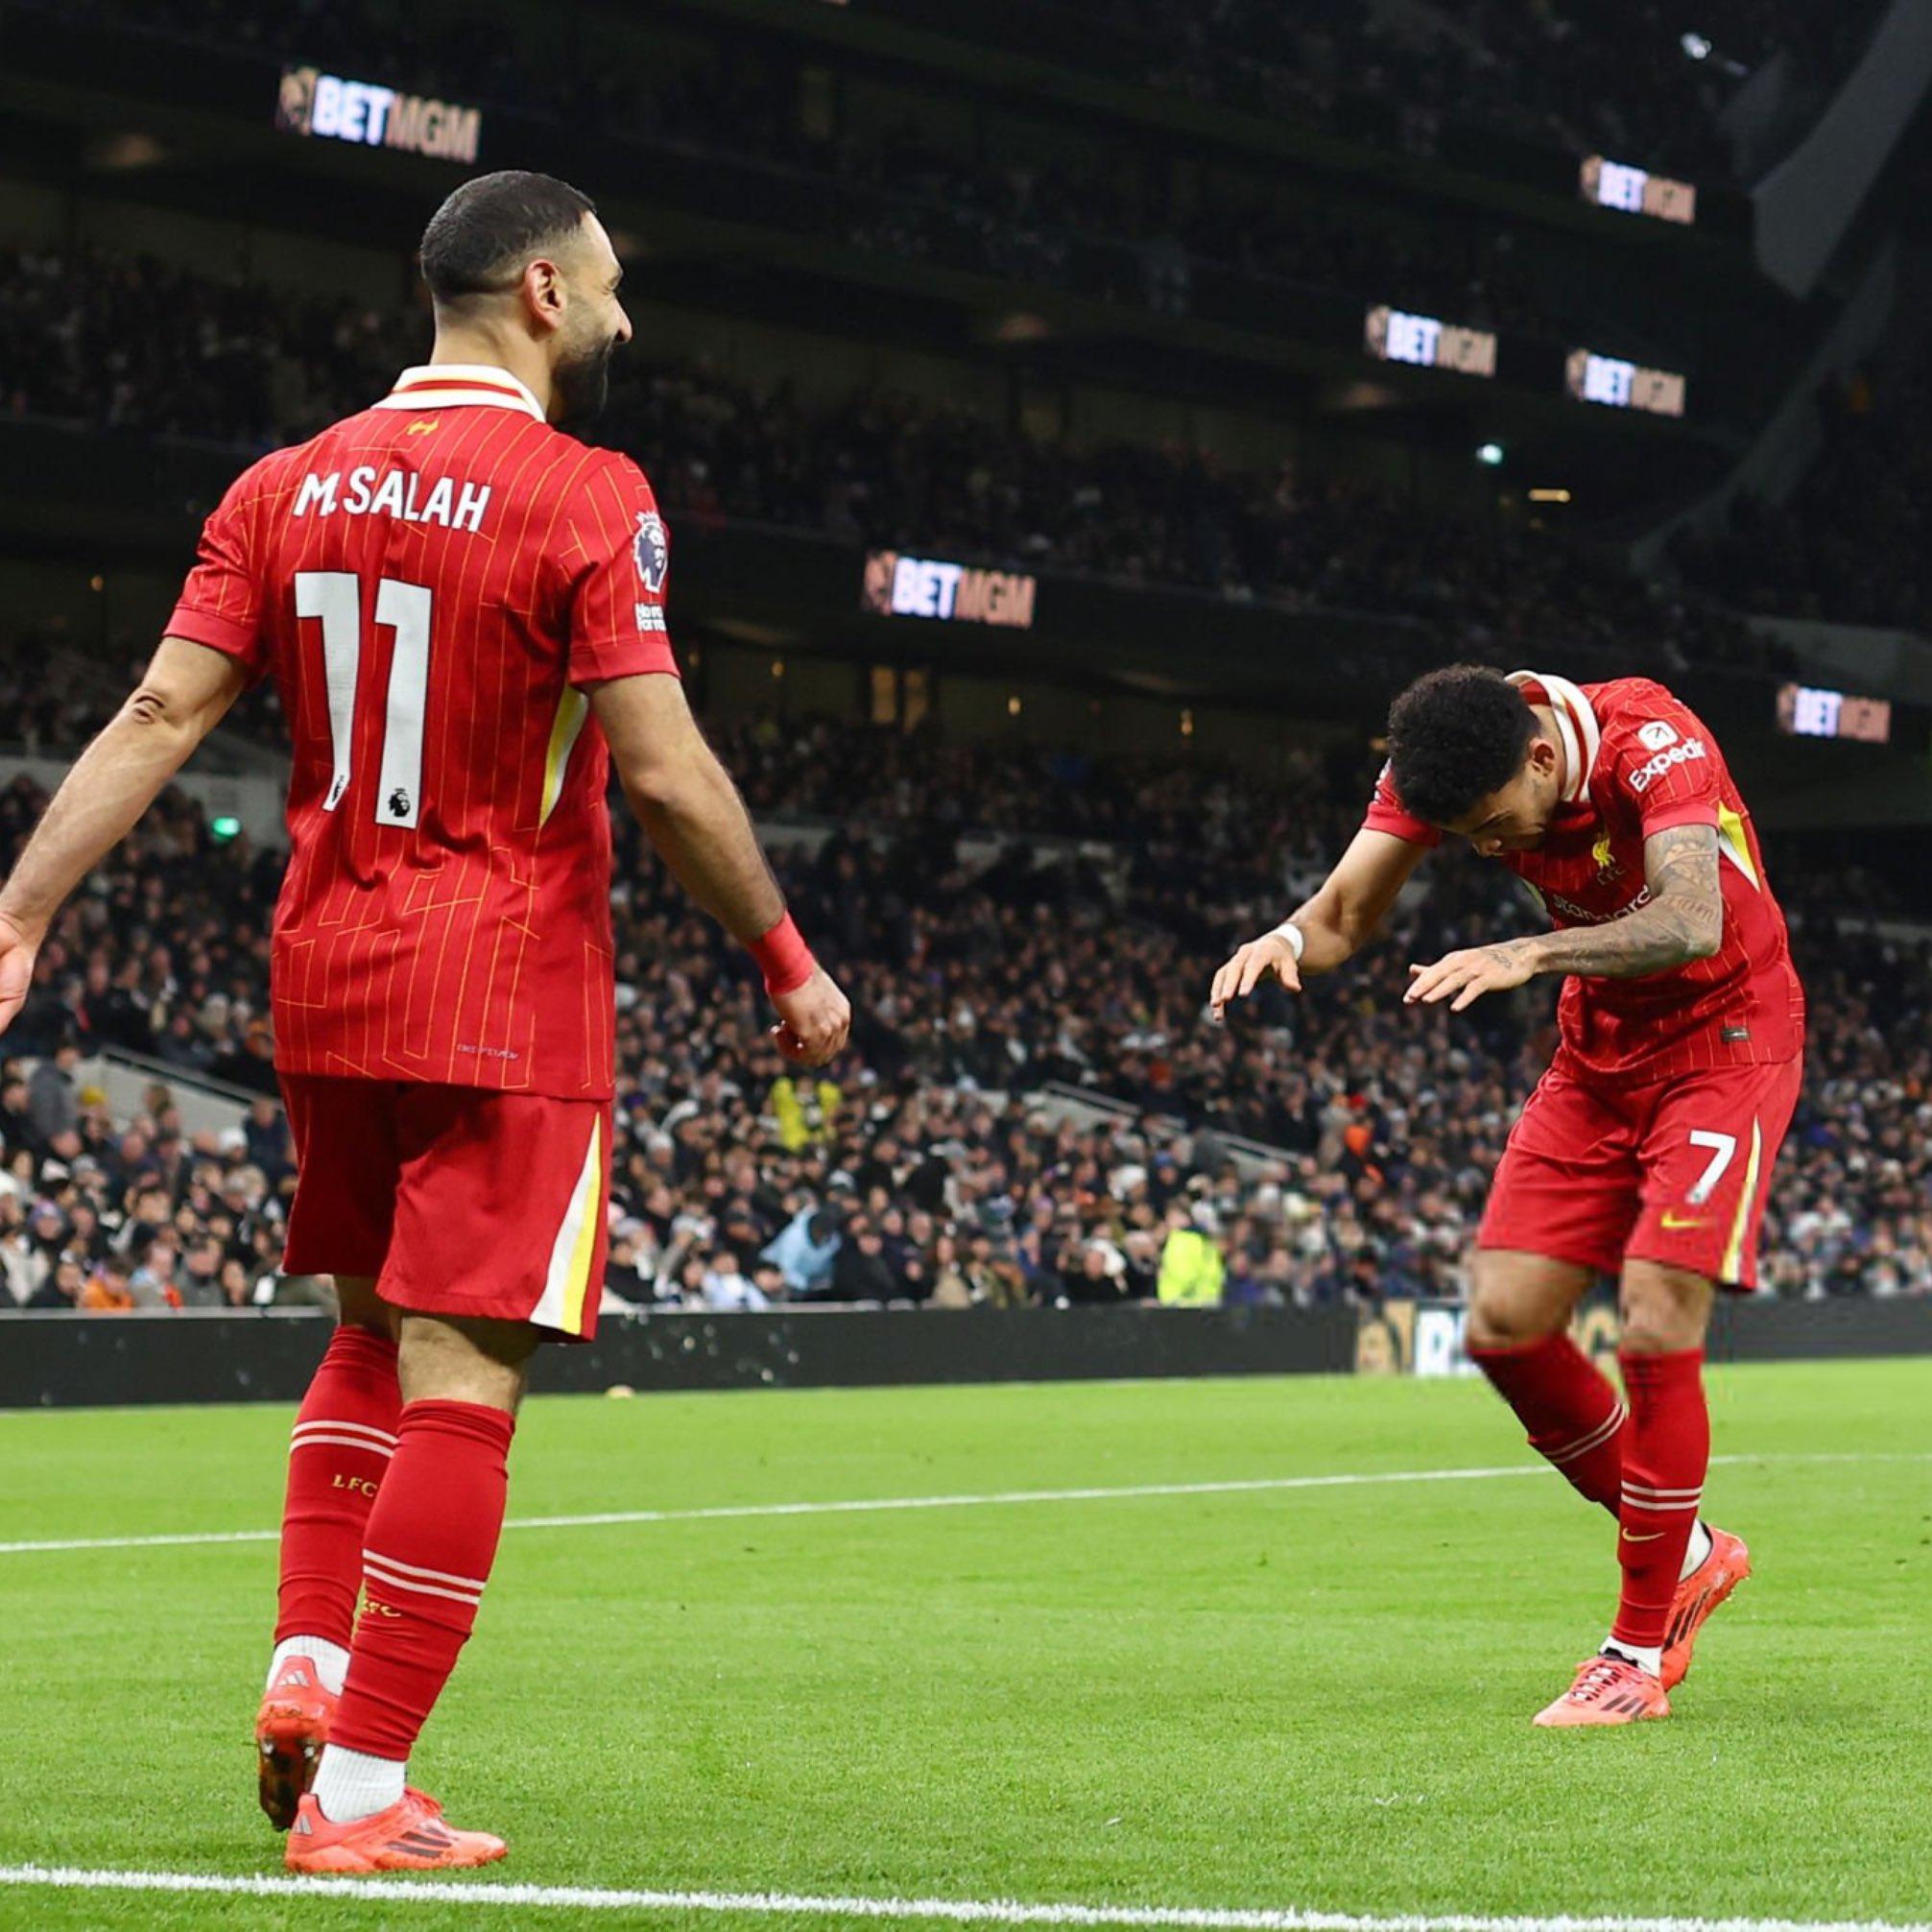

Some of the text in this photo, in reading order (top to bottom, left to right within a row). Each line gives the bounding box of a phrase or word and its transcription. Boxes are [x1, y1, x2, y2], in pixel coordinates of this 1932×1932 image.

[312, 74, 480, 164] BETMGM
[892, 557, 1037, 630] BETMGM
[295, 571, 432, 829] 11
[1629, 737, 1705, 793] Expedi
[1685, 1129, 1736, 1205] 7
[331, 1474, 378, 1497] LFC
